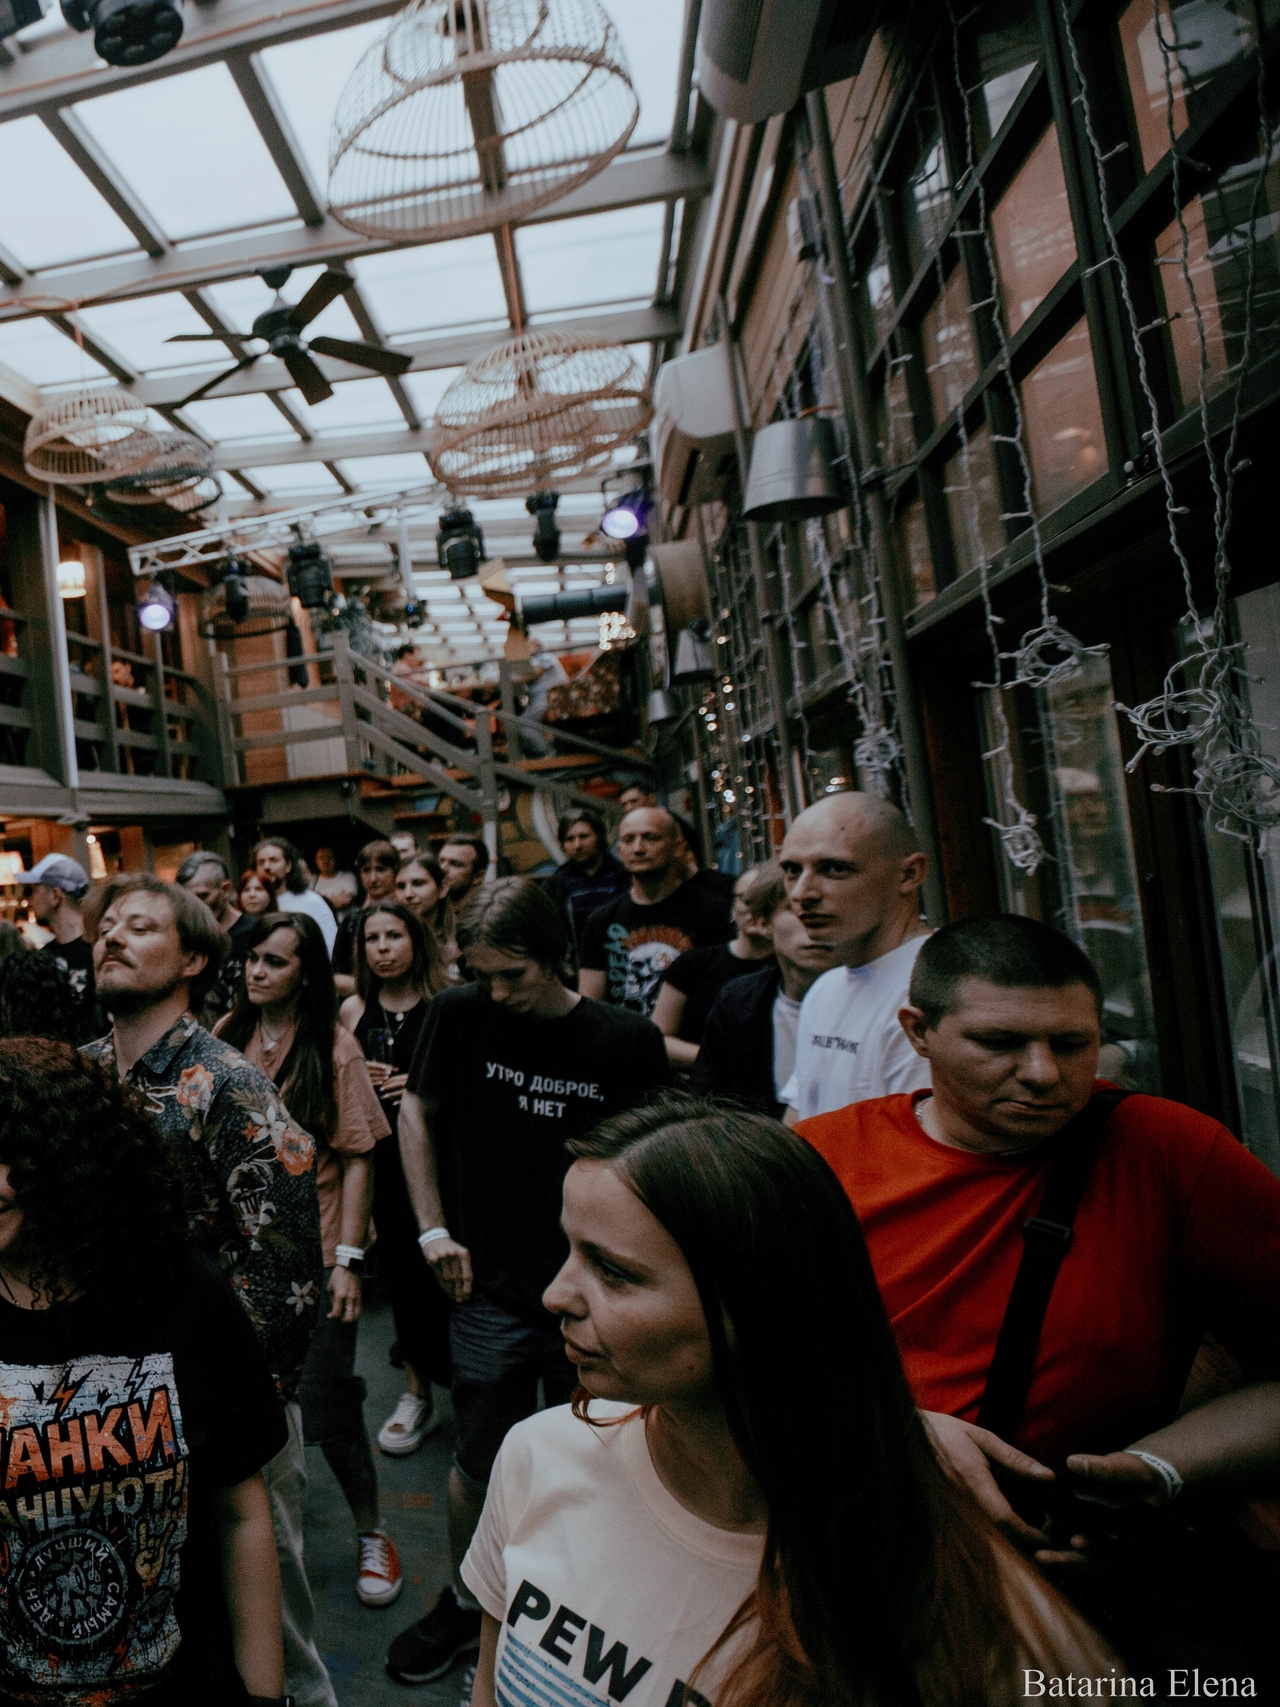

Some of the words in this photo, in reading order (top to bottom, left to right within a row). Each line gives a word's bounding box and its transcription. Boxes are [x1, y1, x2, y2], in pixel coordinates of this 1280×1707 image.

[486, 1061, 524, 1087] УТРО
[529, 1075, 605, 1102] ДОБРОЕ,
[518, 1095, 528, 1111] Я
[532, 1099, 567, 1118] НЕТ
[33, 1536, 110, 1570] ЛУЧШИЙ
[71, 1580, 121, 1639] САМЫЙ
[507, 1579, 653, 1703] PEW
